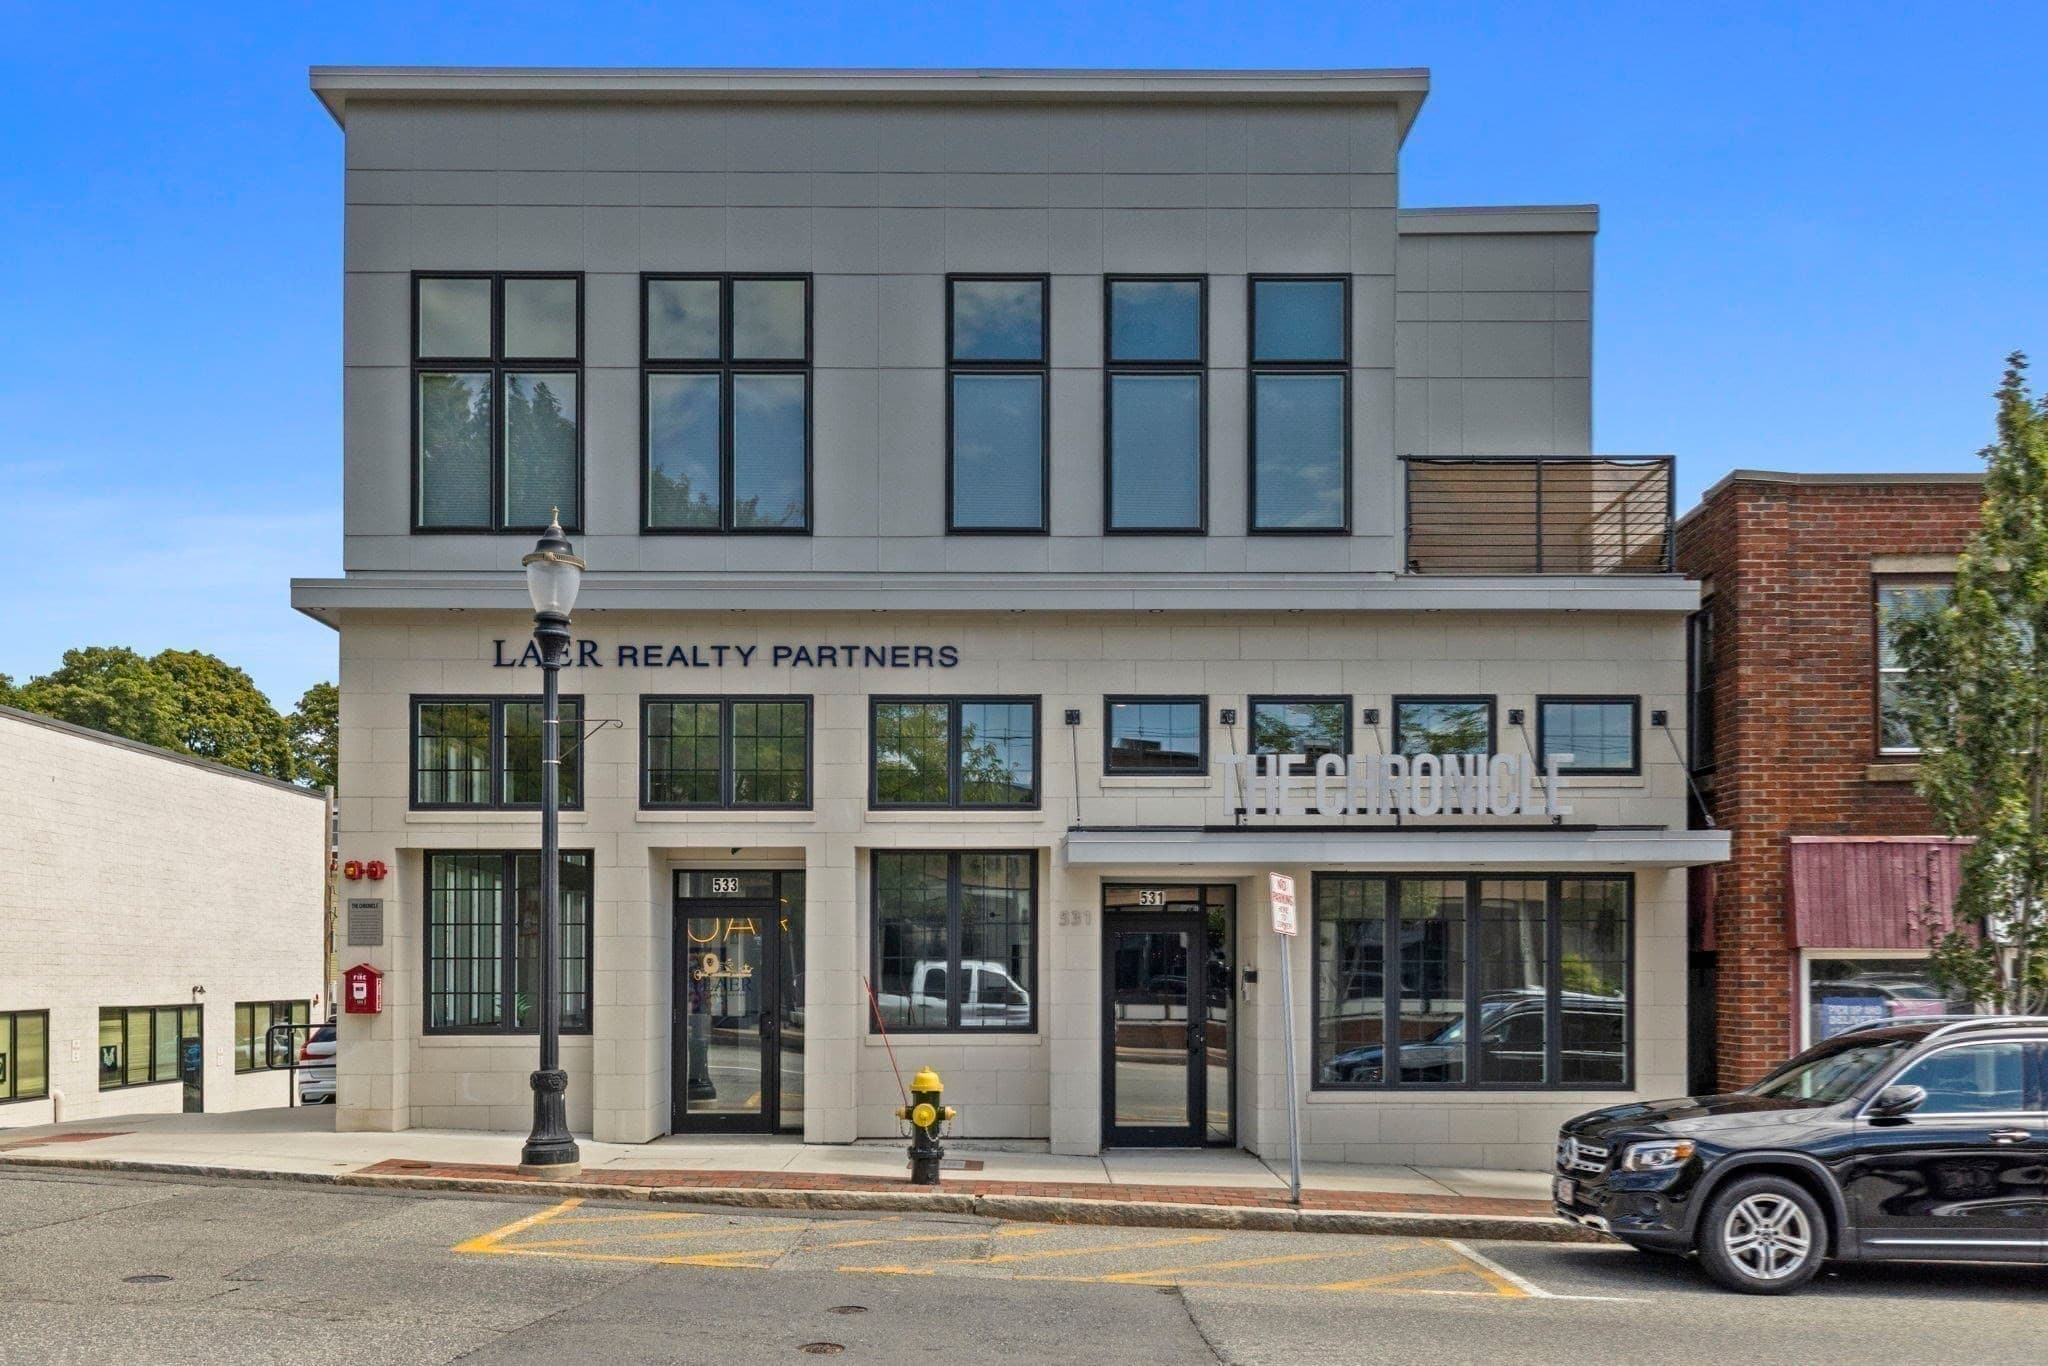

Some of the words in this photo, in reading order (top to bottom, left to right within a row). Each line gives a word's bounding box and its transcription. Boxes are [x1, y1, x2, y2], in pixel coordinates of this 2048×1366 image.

[617, 645, 757, 668] REALTY
[773, 645, 959, 668] PARTNERS
[1215, 753, 1306, 816] THE
[1315, 753, 1575, 817] CHRONICLE
[713, 878, 738, 892] 533
[1276, 879, 1288, 891] NO
[1140, 891, 1164, 905] 531
[1272, 891, 1295, 905] PARKING
[1058, 910, 1093, 927] 531
